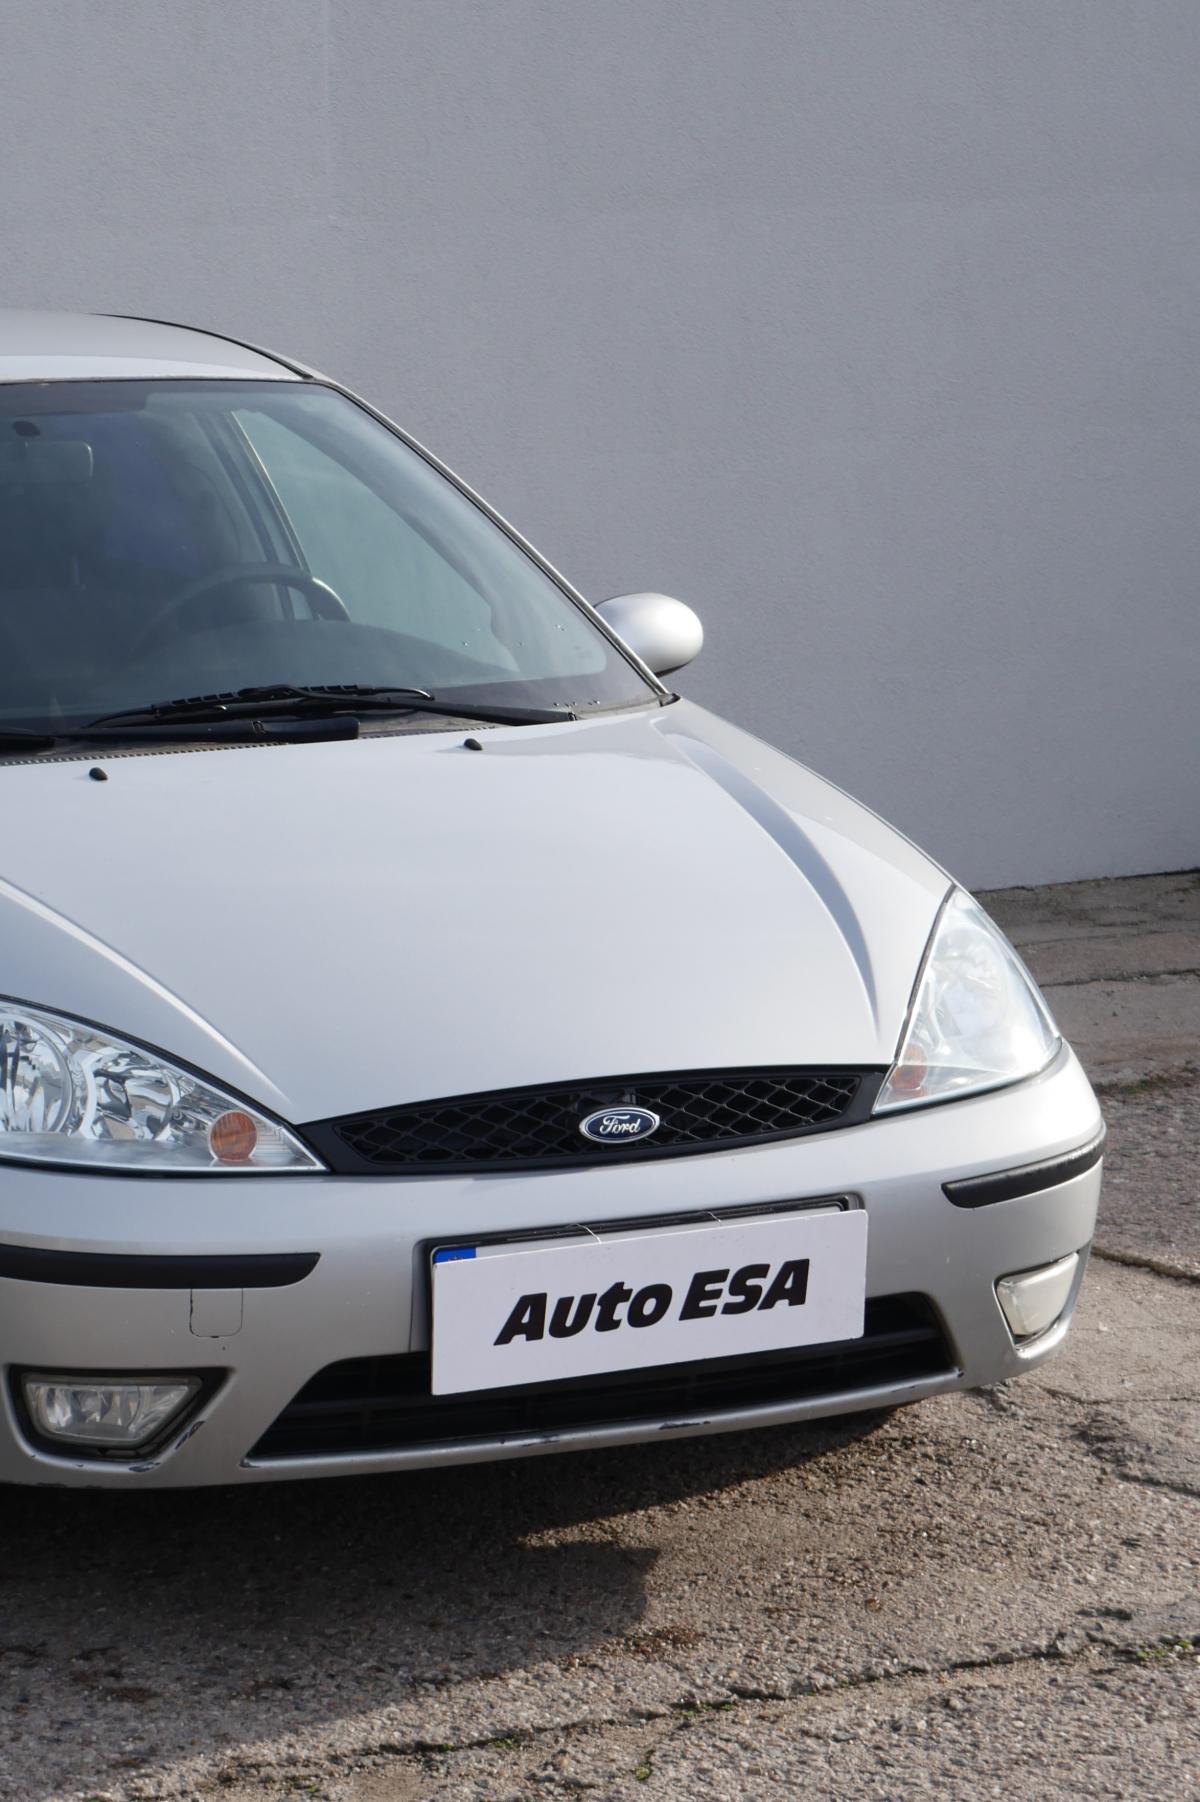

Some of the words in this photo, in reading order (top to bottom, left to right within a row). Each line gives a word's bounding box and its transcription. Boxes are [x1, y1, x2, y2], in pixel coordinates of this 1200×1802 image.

[600, 1115, 641, 1134] Ford
[493, 1281, 673, 1346] Auto
[678, 1258, 810, 1322] ESA
